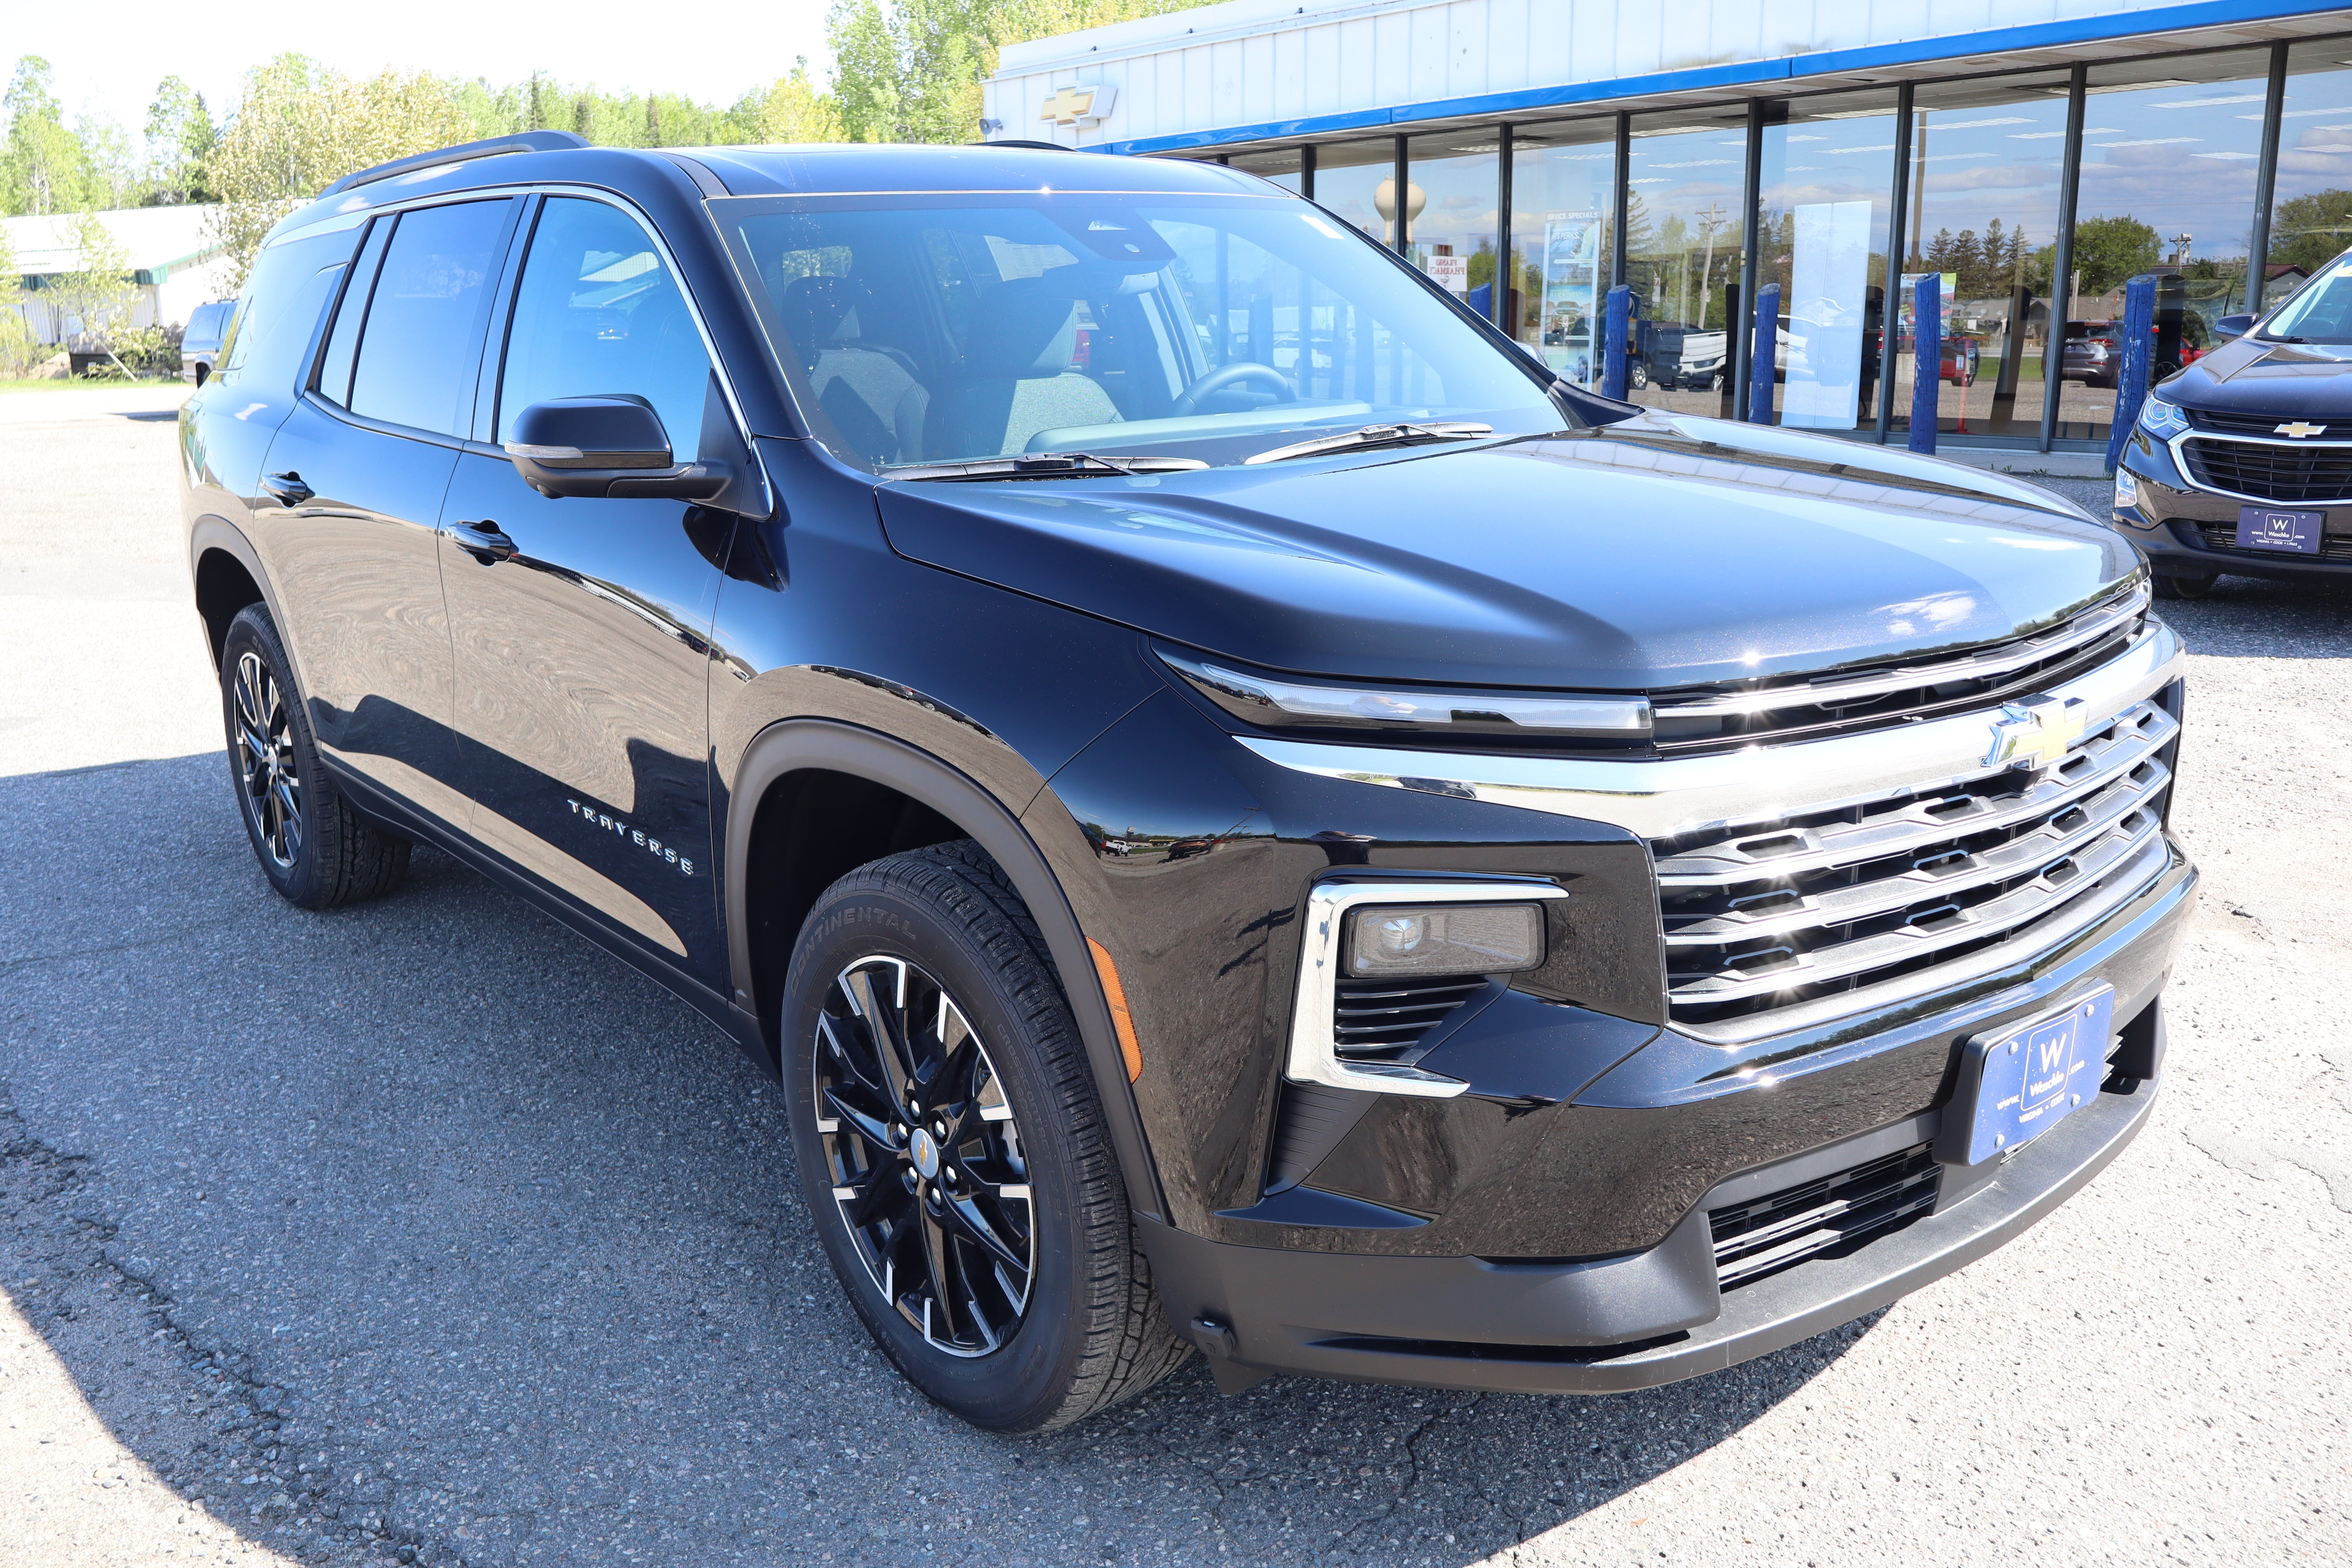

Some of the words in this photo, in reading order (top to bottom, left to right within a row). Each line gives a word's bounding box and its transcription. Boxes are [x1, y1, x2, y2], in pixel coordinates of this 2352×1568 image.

[2272, 519, 2288, 531] W
[567, 798, 694, 875] TRAVERSE
[791, 906, 916, 998] CONTINENTAL
[2040, 1033, 2067, 1074] W
[1996, 1094, 2020, 1111] www.
[2030, 1070, 2065, 1097] Waschke
[2069, 1060, 2085, 1076] .com
[2018, 1107, 2043, 1123] VIRGINIA
